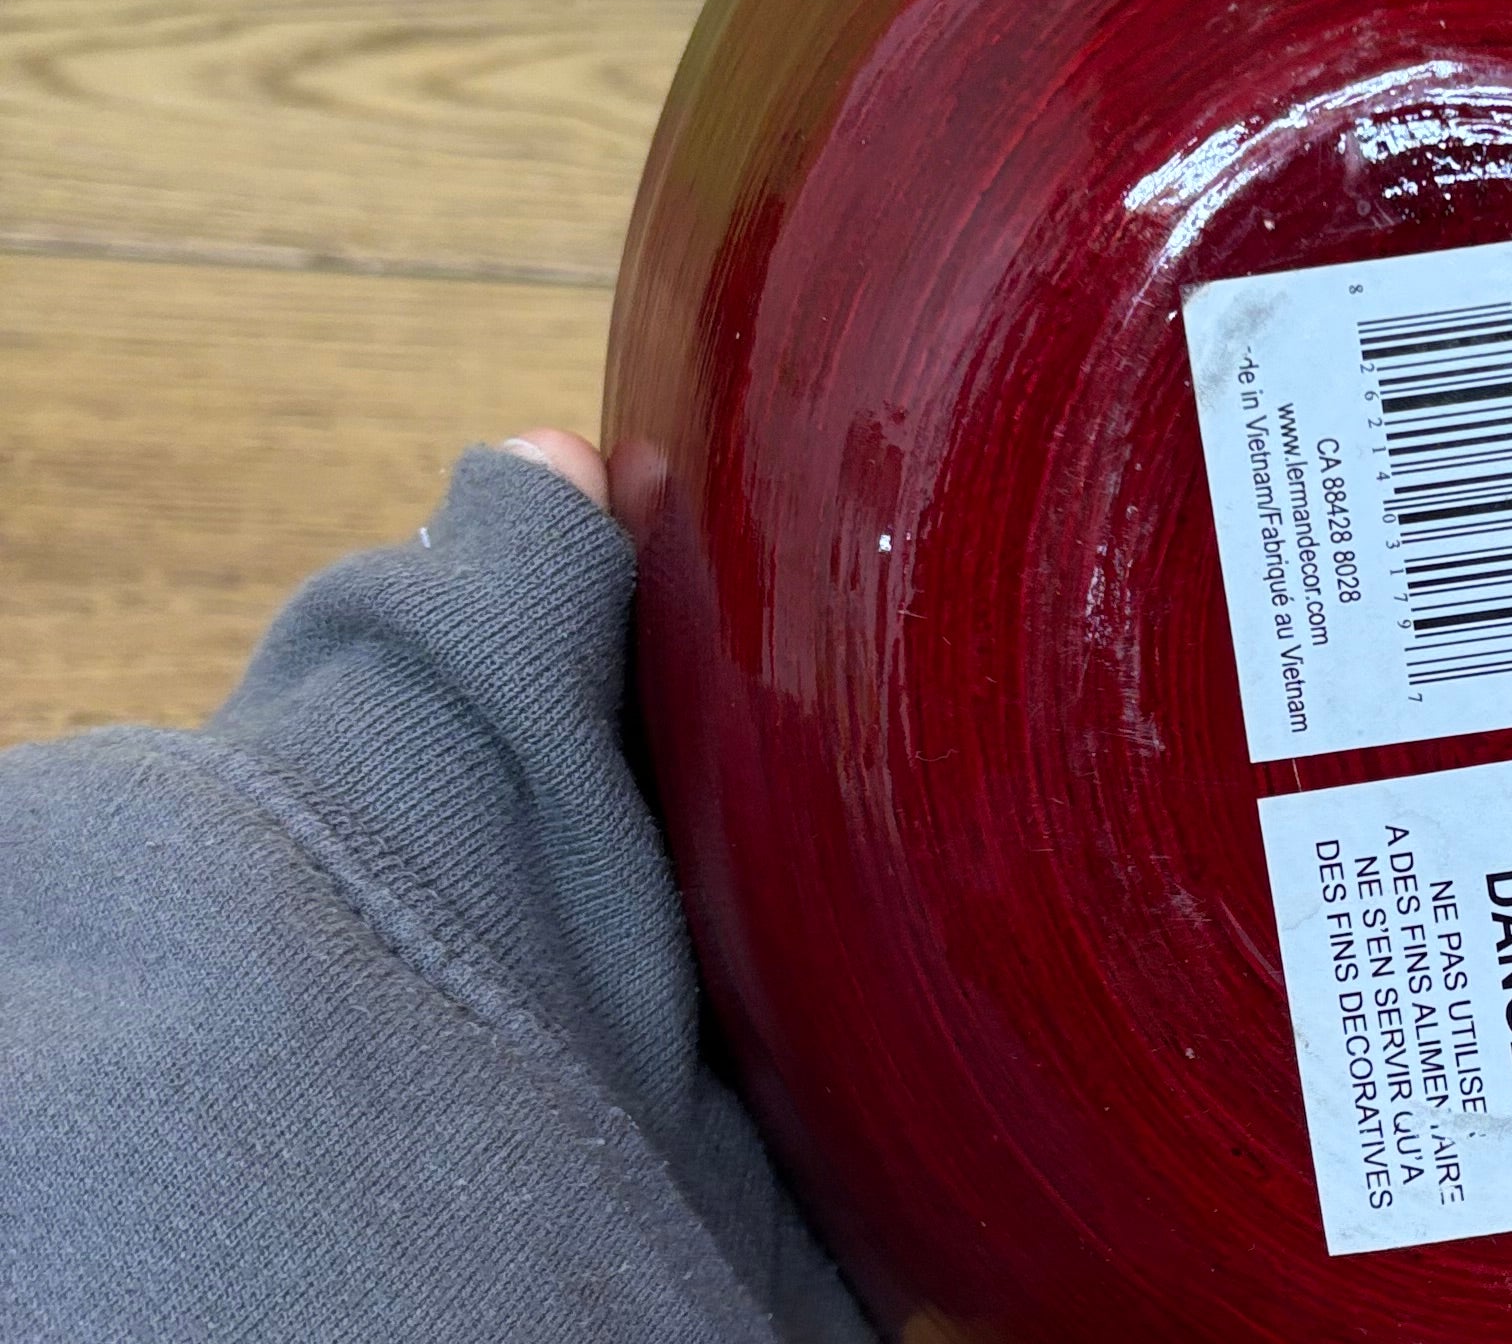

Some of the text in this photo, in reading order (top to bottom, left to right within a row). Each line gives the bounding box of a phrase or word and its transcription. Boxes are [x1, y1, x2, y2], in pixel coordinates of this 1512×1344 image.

[1236, 345, 1308, 734] de in Vietnam/Fabriqué au Vietnam
[1275, 401, 1329, 647] www.lermandecor.com
[1315, 437, 1362, 604] CA 88428 8028
[1352, 854, 1384, 901] NE
[1360, 907, 1396, 979] S'EN
[1314, 838, 1393, 1210] DES FINS DECORATIVES
[1372, 986, 1413, 1104] SERVIR
[1383, 824, 1465, 1206] A DES FINS ALIMENAIRE
[1427, 879, 1488, 1139] NE PAS UTILISE
